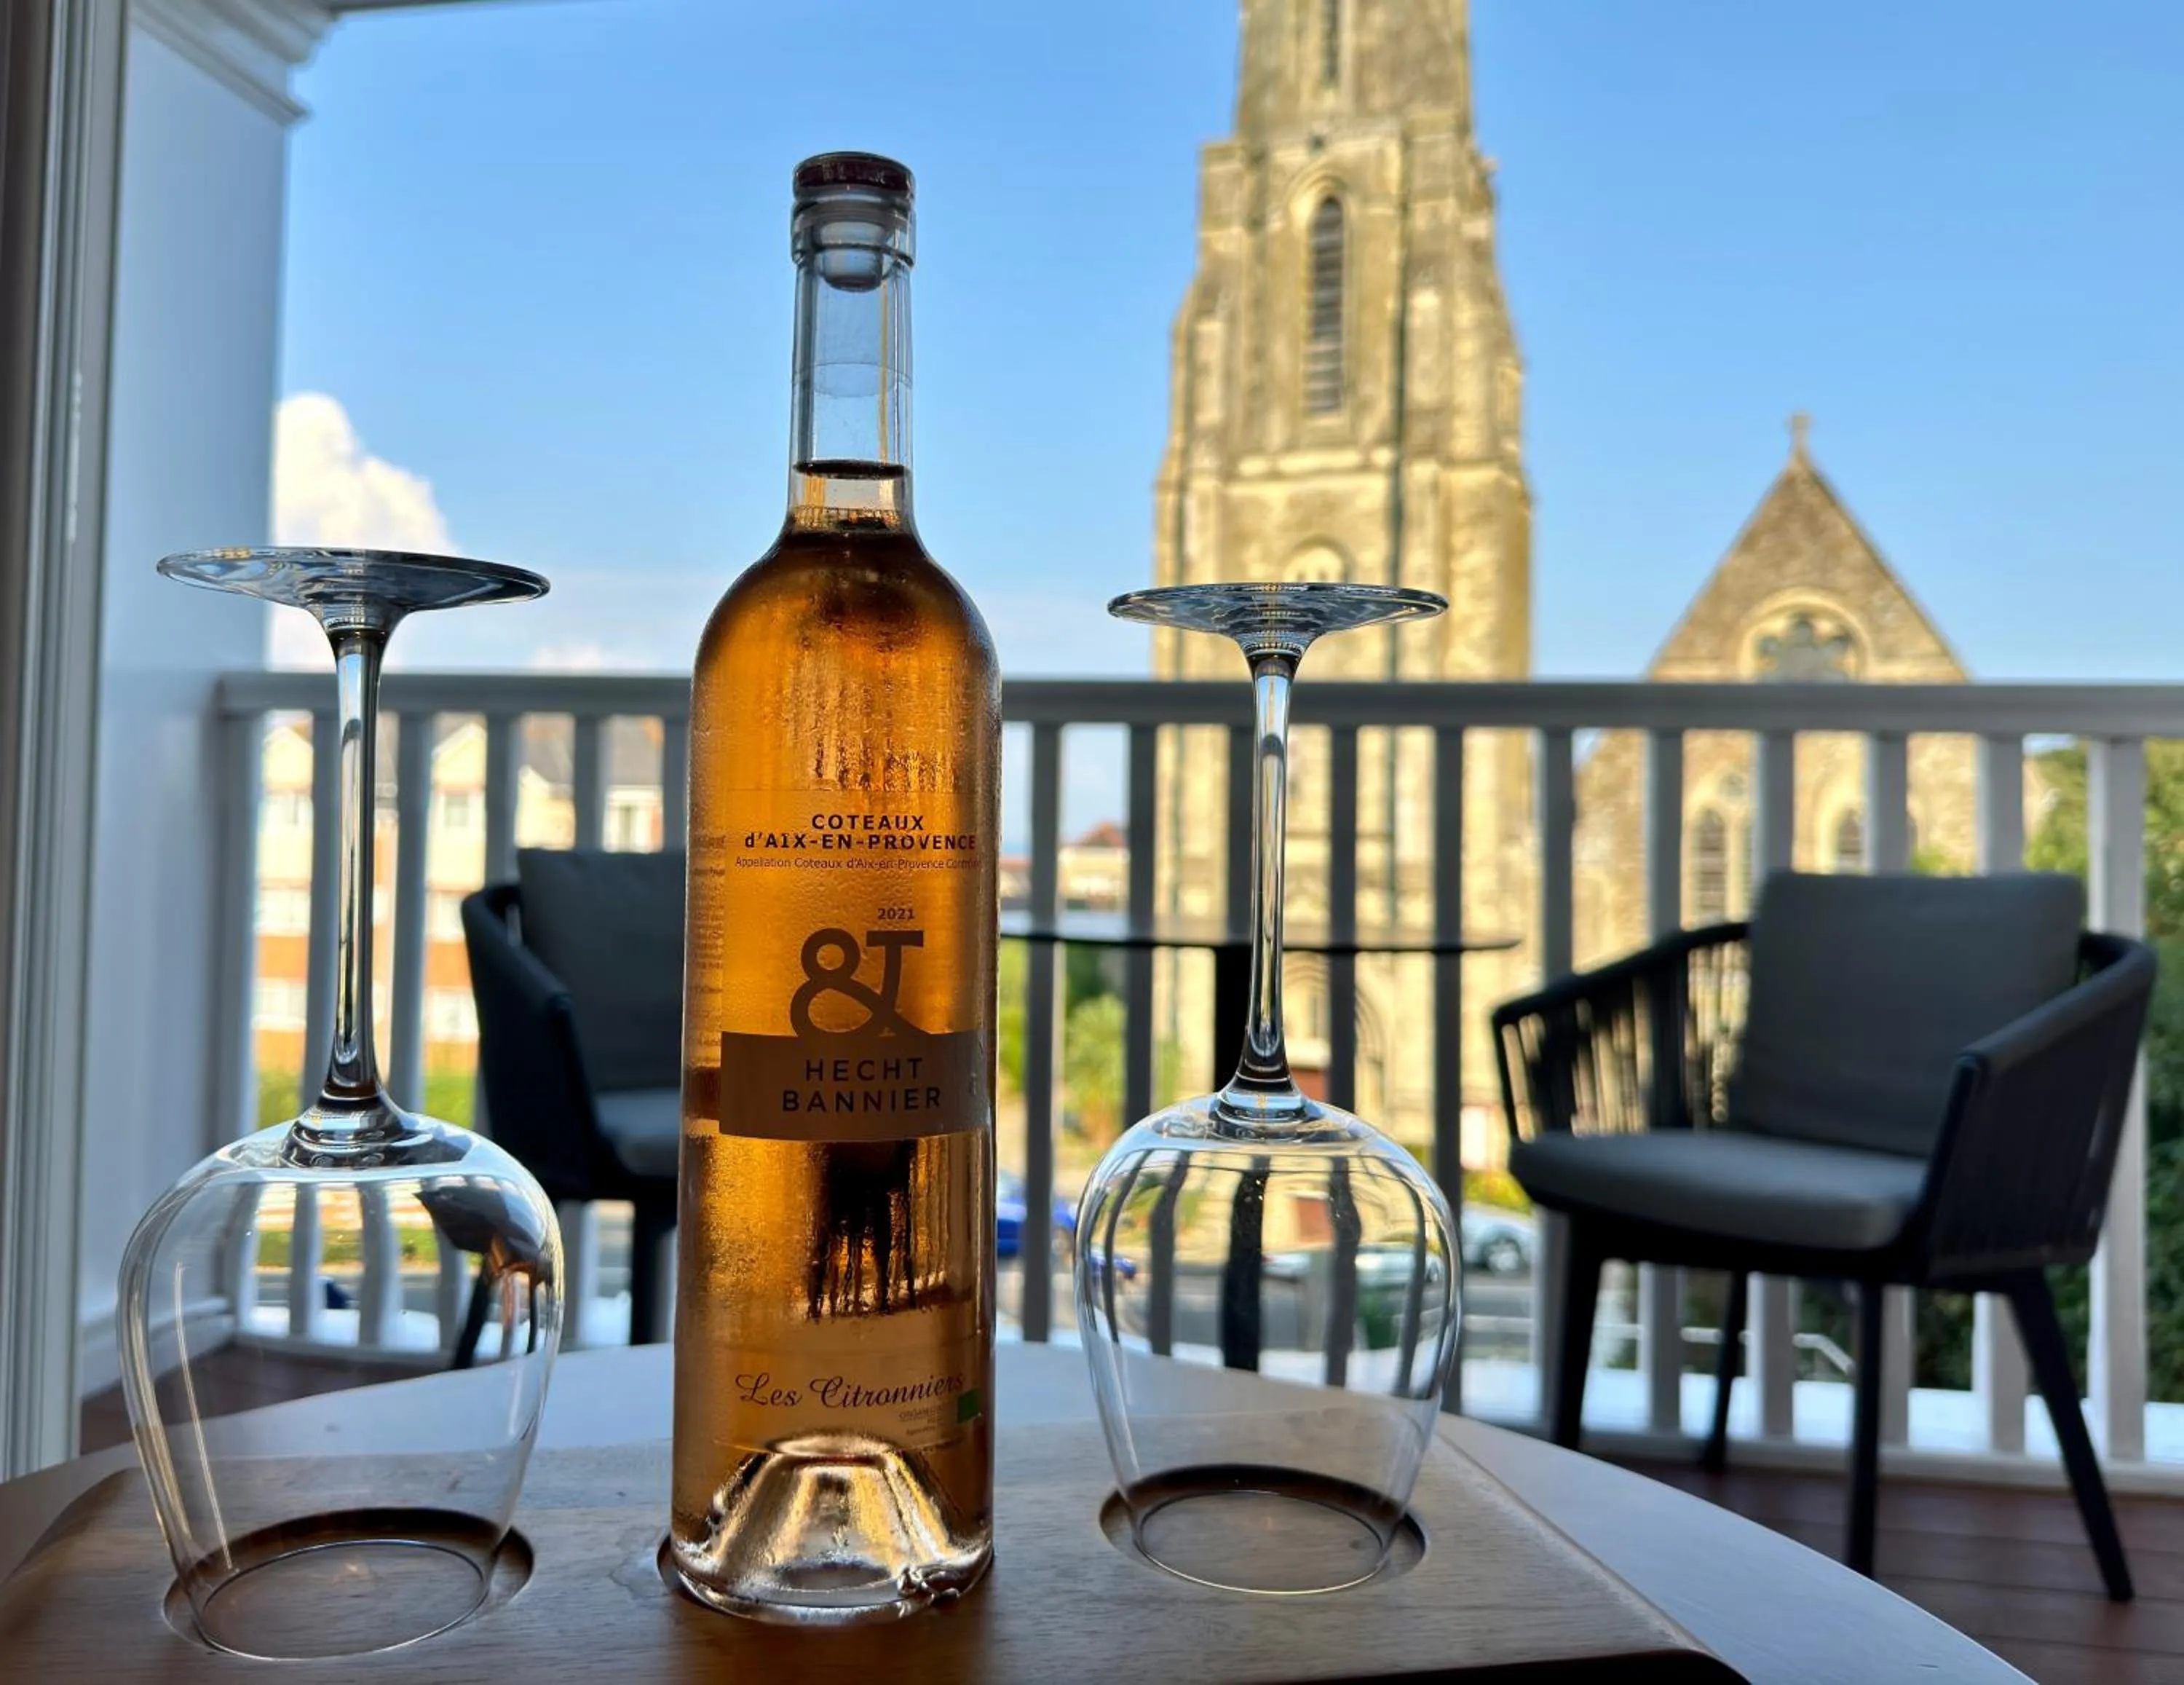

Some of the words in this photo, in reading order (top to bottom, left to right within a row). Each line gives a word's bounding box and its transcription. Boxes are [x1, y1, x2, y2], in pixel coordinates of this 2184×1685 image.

[812, 814, 924, 830] COTEAUX
[745, 832, 976, 850] d'AIX-EN-PROVENCE
[736, 856, 791, 868] Appellation
[794, 857, 842, 869] Coteaux
[877, 908, 914, 920] 2021
[806, 1058, 922, 1081] HECHT
[783, 1087, 941, 1111] BANNIER
[735, 1373, 802, 1407] Les
[810, 1372, 965, 1408] Citronniers
